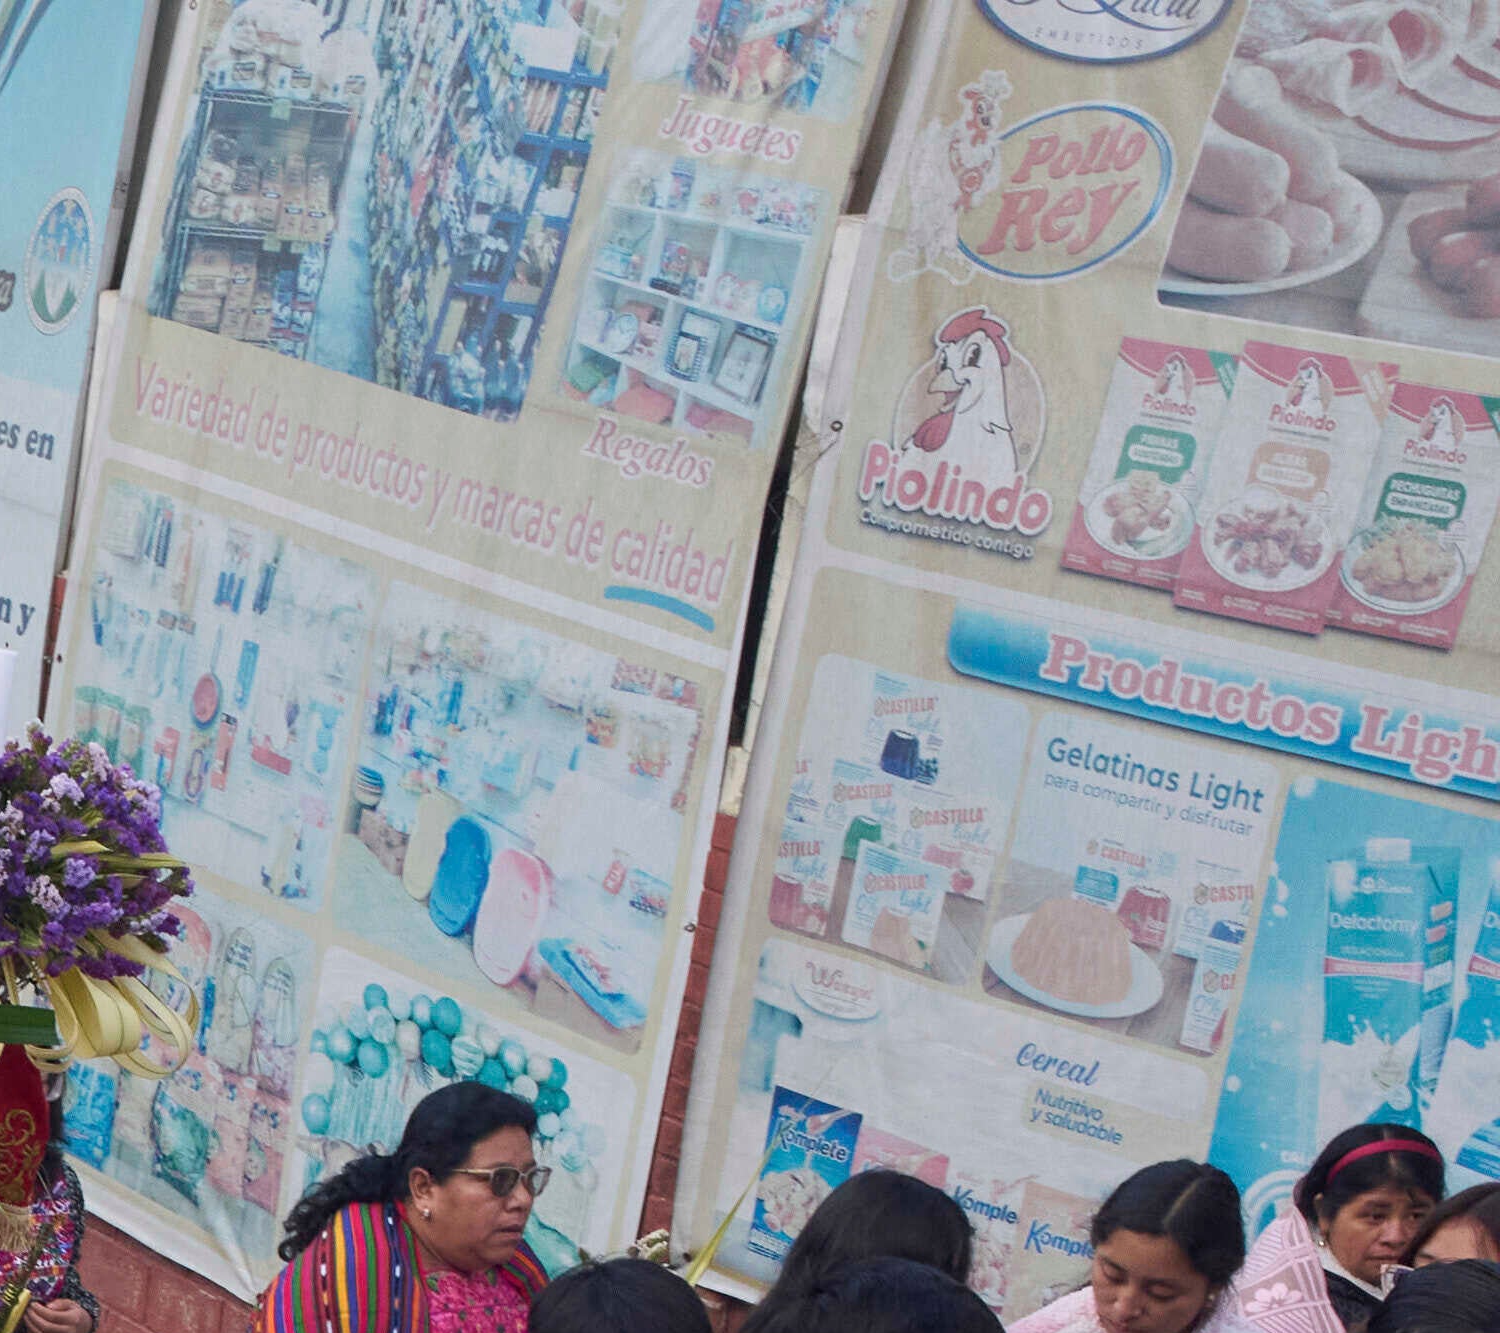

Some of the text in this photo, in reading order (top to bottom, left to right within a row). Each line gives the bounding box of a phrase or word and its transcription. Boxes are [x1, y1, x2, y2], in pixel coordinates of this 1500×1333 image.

[663, 98, 800, 160] Juguetes
[1011, 122, 1148, 183] Pollo
[977, 179, 1141, 255] Rey
[26, 429, 55, 460] en
[1269, 404, 1337, 432] Piolindo
[585, 416, 713, 485] Regalos
[1404, 439, 1468, 464] Piolindo
[135, 355, 733, 602] Variedad de productos y marcas de calidad
[861, 442, 1050, 531] Piolindo
[17, 603, 35, 636] y
[1040, 634, 1342, 744] Productos
[1047, 737, 1265, 813] Gelatinas Light
[923, 808, 985, 826] CASTILLA
[1044, 773, 1080, 795] para
[1082, 781, 1163, 816] compartir
[1179, 804, 1254, 836] disfrutar
[1017, 1042, 1101, 1087] Cereal
[1028, 1105, 1124, 1146] y saludable
[1035, 1088, 1105, 1122] Nutritivo
[777, 1117, 848, 1162] Komplete
